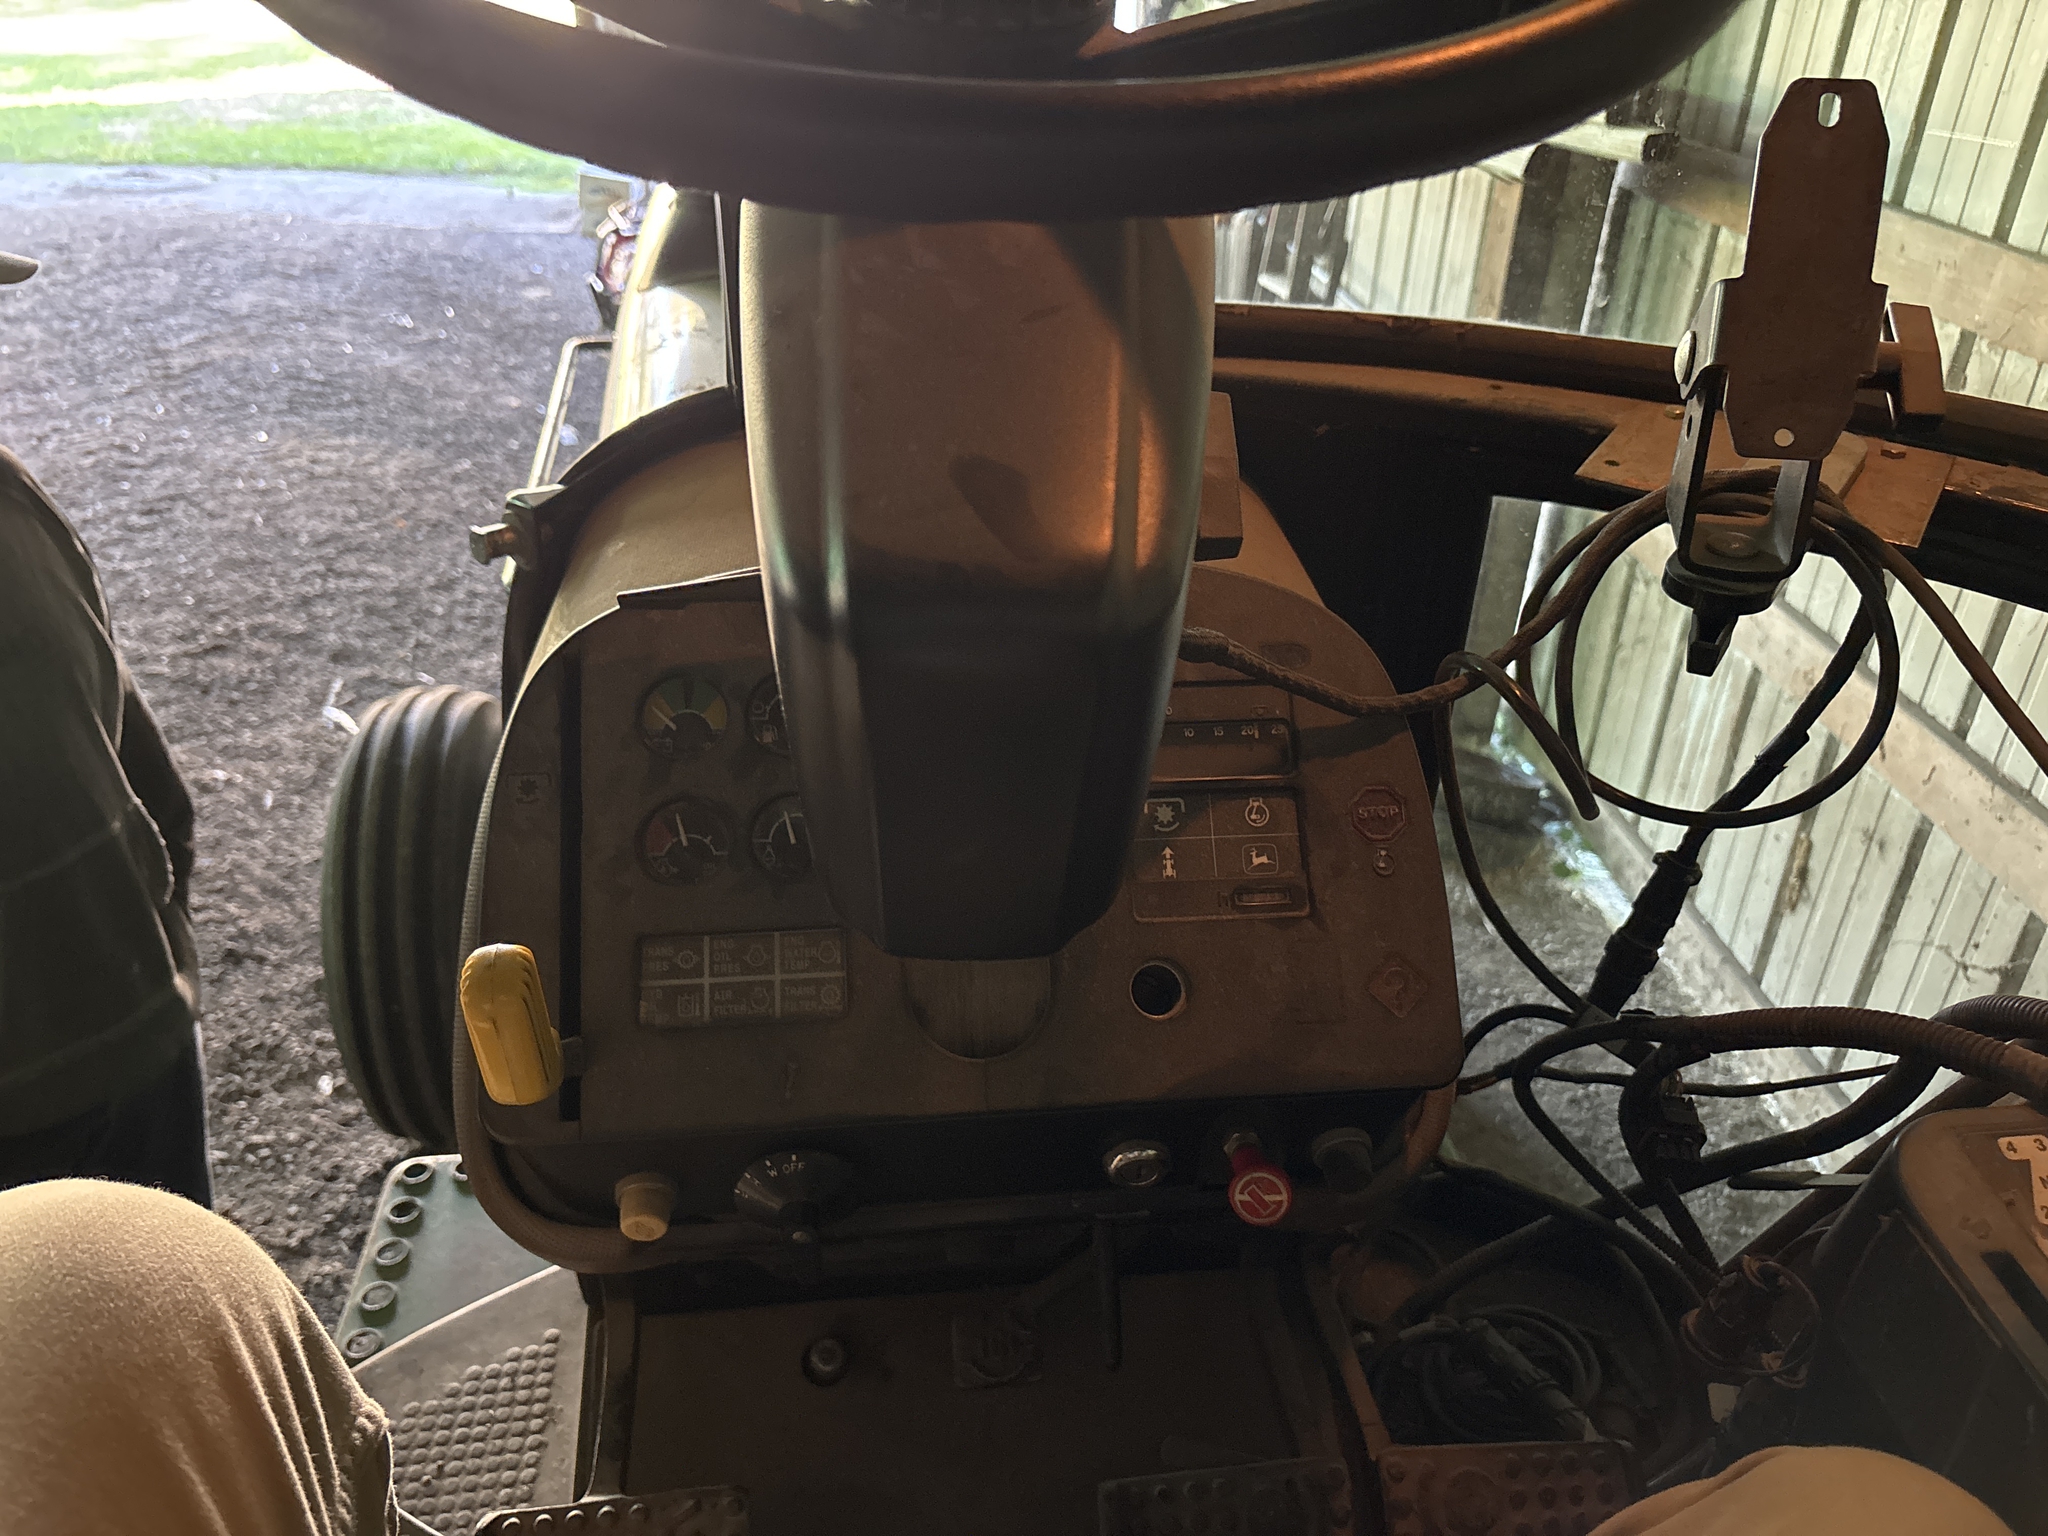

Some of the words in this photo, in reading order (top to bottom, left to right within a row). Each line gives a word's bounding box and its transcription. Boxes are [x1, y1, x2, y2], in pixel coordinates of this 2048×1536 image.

[1183, 728, 1195, 737] 10
[1213, 726, 1224, 736] 15
[1241, 726, 1253, 735] 20
[1358, 805, 1399, 818] STOP
[713, 939, 735, 949] ENG
[713, 951, 731, 962] OIL
[784, 947, 817, 958] WATER
[713, 962, 741, 974] PRES
[713, 989, 733, 1001] AIR
[784, 986, 816, 997] TRANS
[713, 1004, 748, 1016] FILTER
[784, 1000, 818, 1013] FILTER
[2006, 1140, 2018, 1153] 4
[2033, 1138, 2047, 1152] 3
[767, 1167, 778, 1177] W
[782, 1162, 806, 1174] OFF
